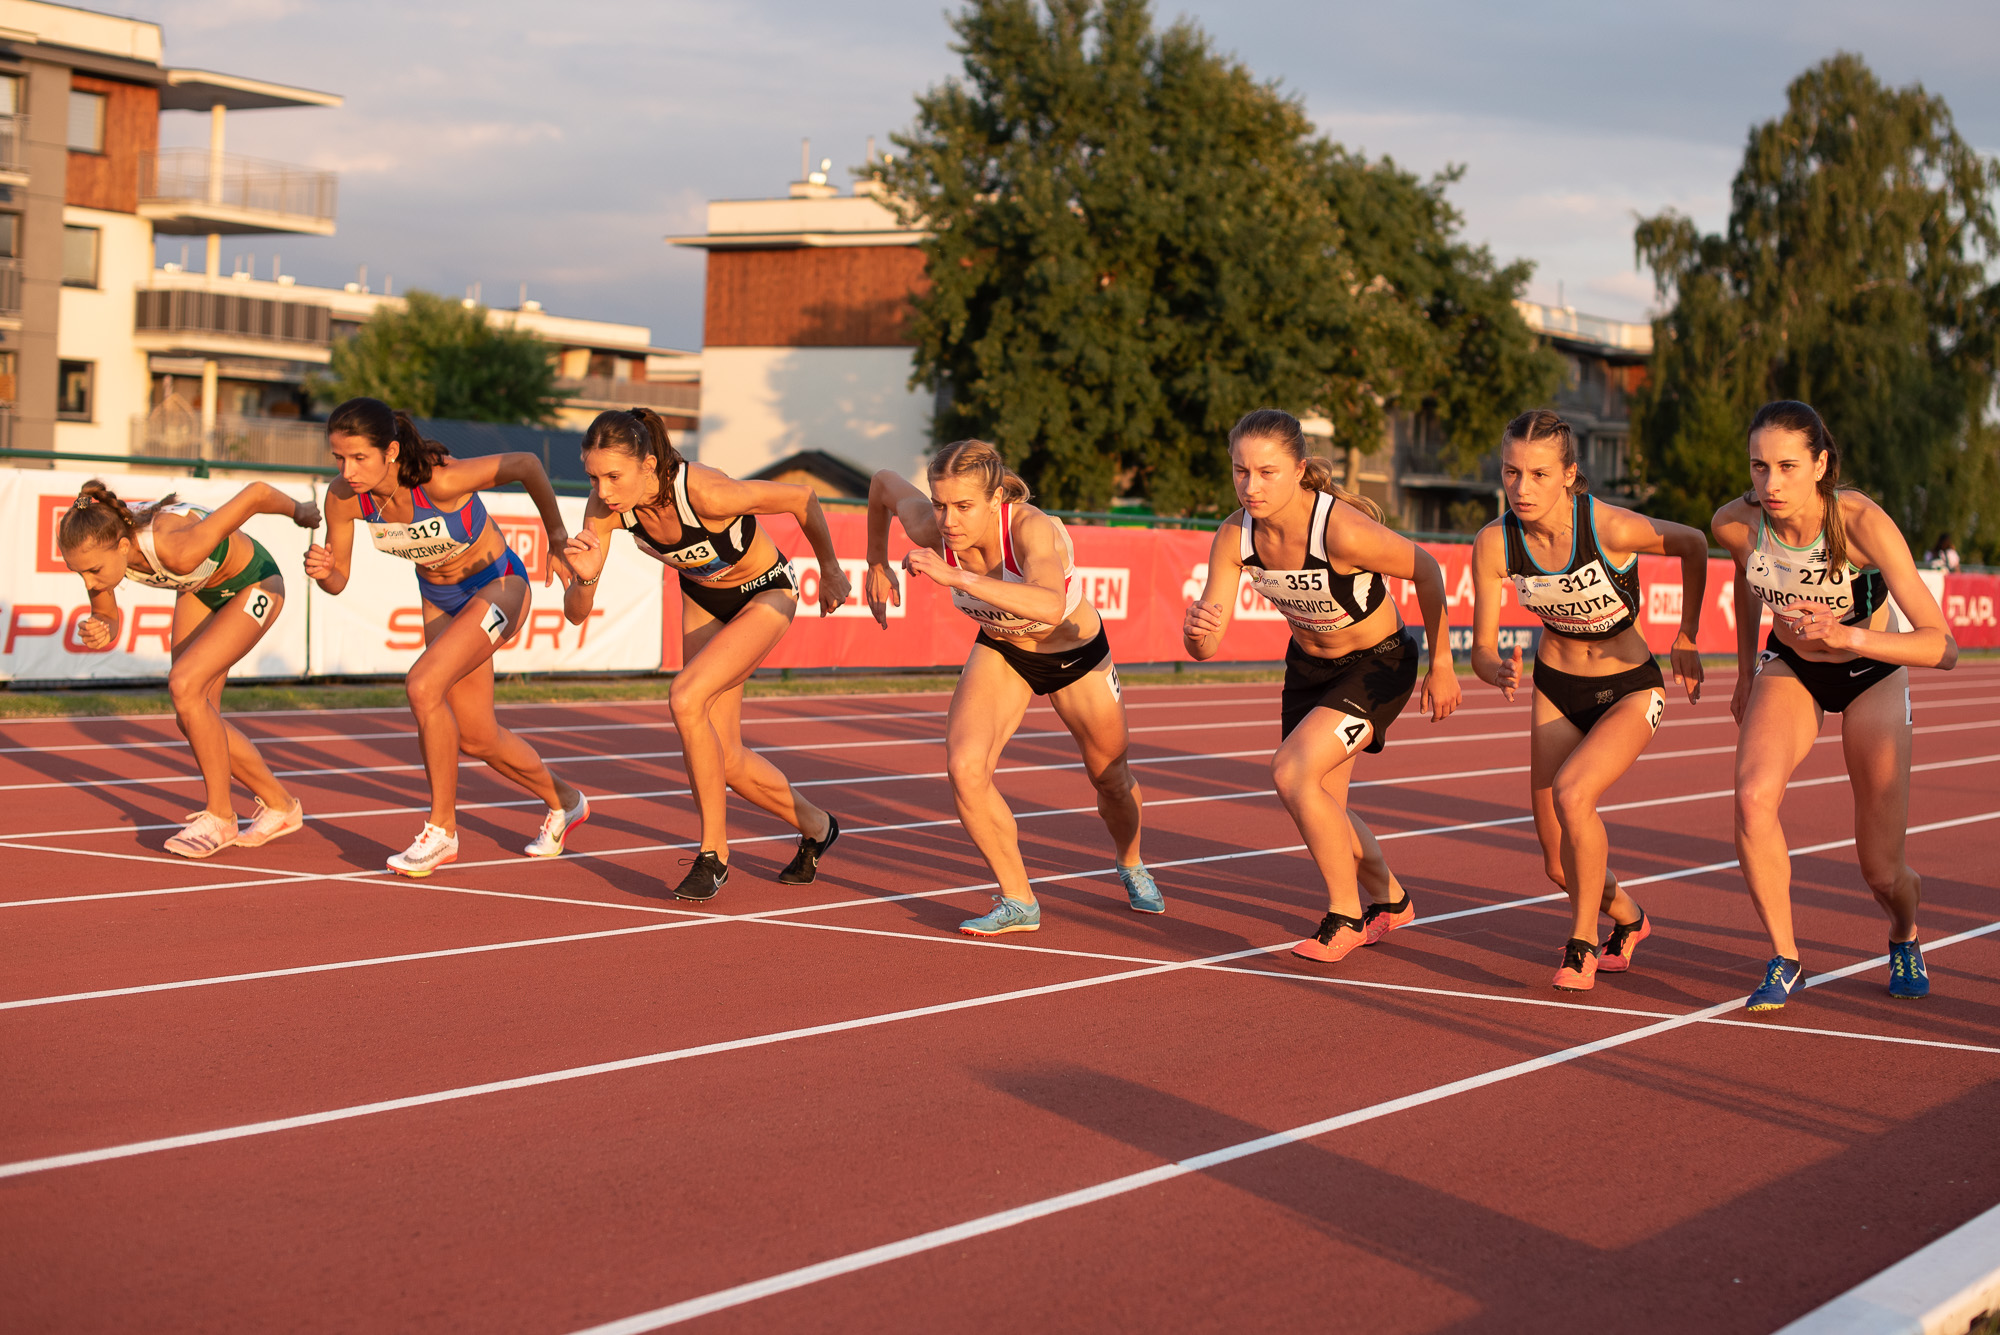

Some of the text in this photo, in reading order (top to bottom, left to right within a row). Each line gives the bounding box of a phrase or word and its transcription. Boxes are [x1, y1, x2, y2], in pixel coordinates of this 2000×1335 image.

[408, 521, 441, 540] 319
[672, 545, 710, 563] 143
[740, 561, 784, 593] NIKE PRO
[788, 564, 799, 591] 6
[1285, 572, 1323, 591] 355
[1558, 567, 1602, 593] 312
[1799, 567, 1844, 586] 270
[252, 594, 269, 618] 8
[488, 609, 505, 633] 7
[1593, 618, 1617, 632] 2021
[1111, 666, 1120, 694] 5
[1651, 699, 1665, 729] 3
[1343, 722, 1366, 747] 4
